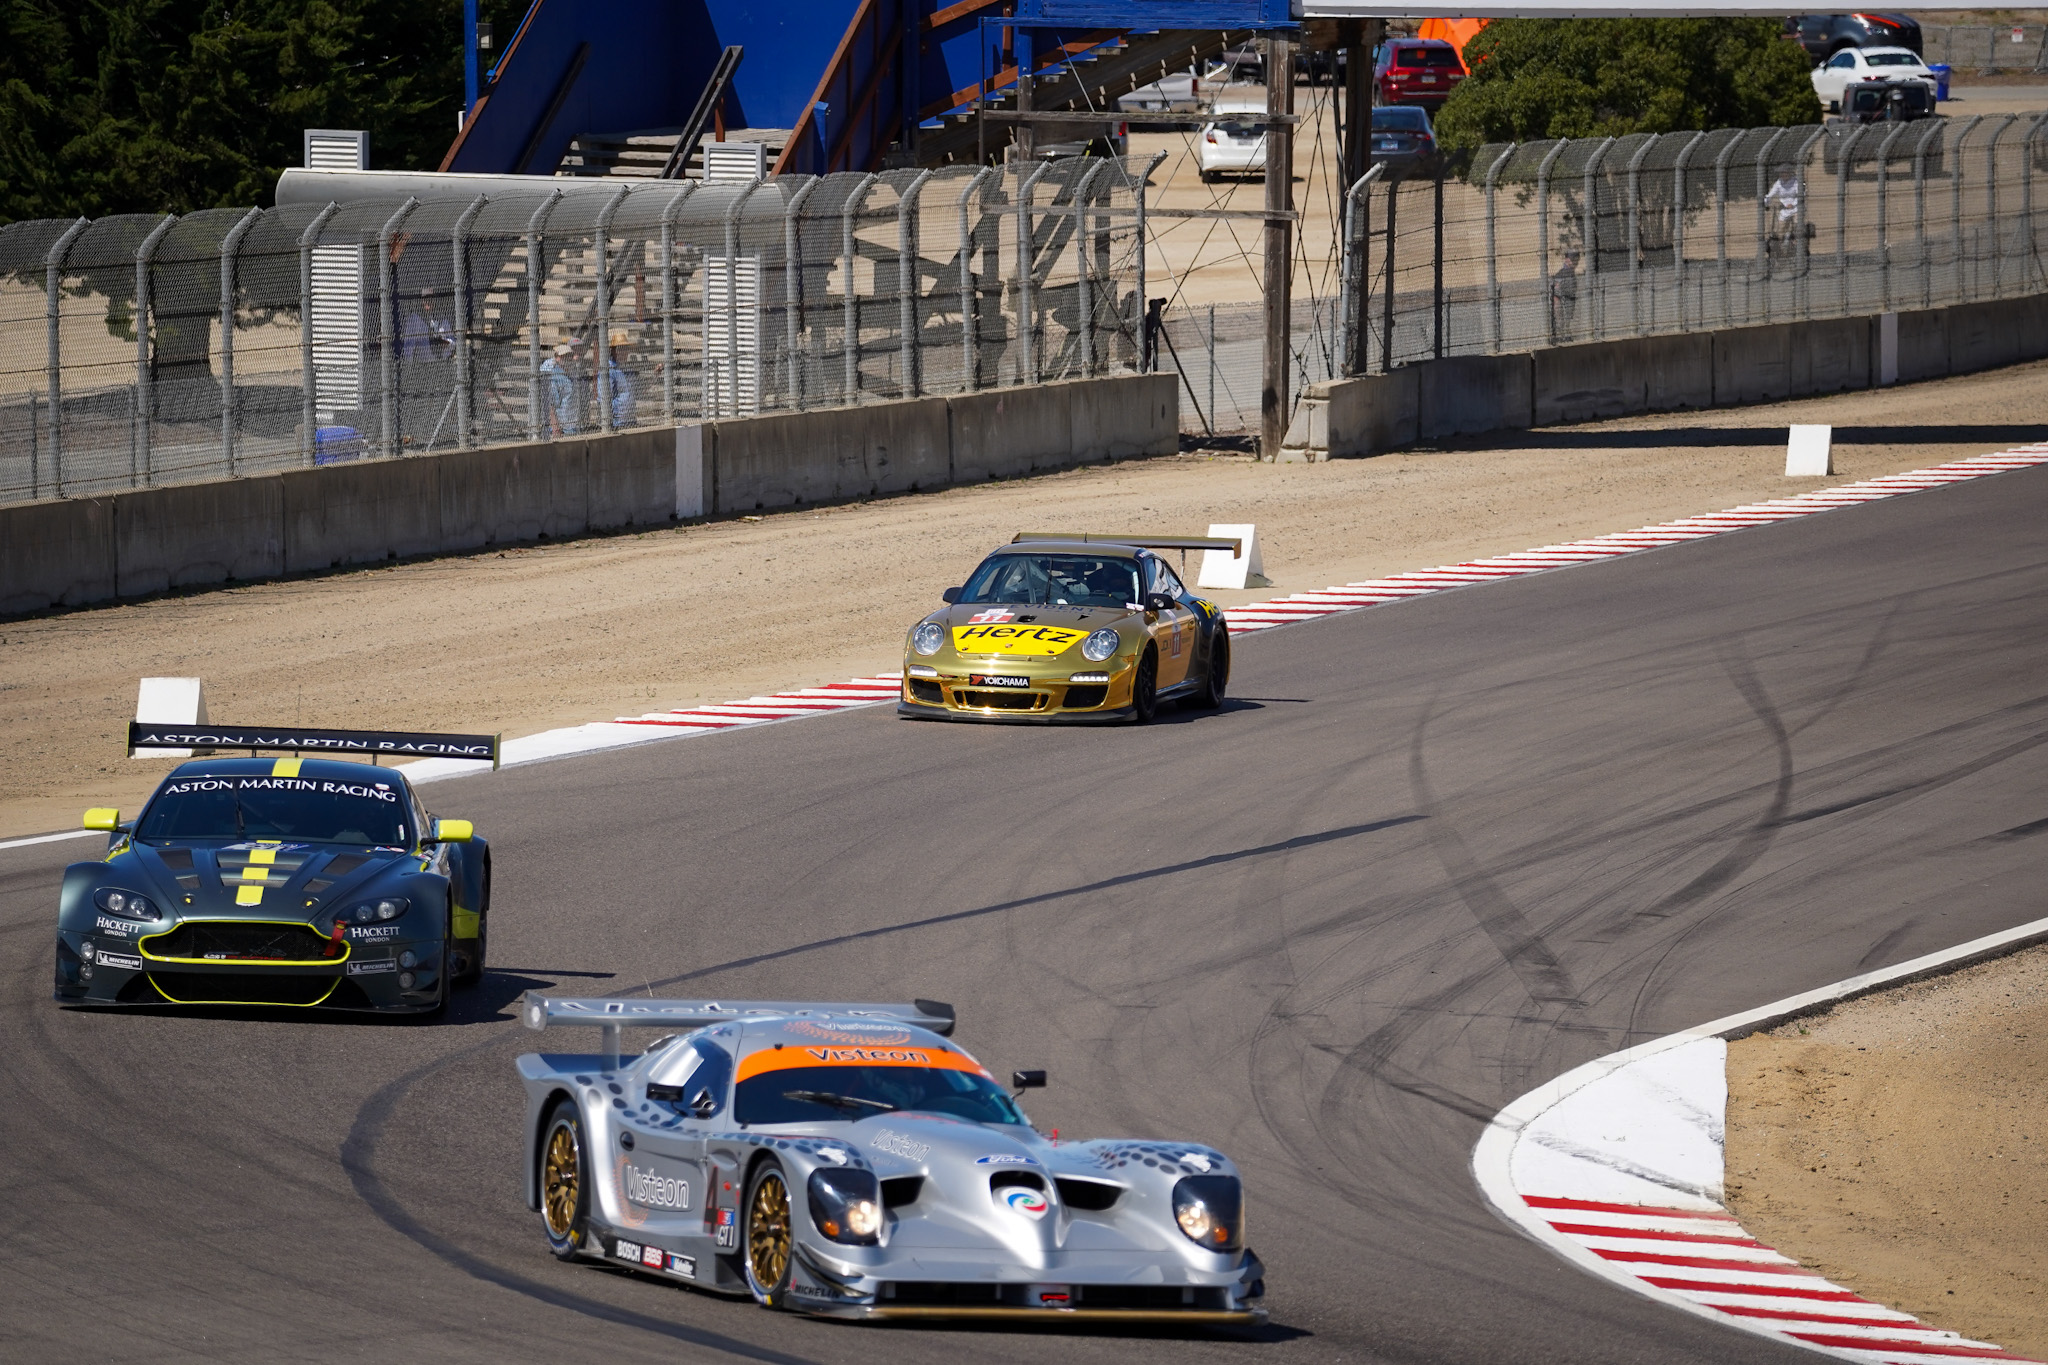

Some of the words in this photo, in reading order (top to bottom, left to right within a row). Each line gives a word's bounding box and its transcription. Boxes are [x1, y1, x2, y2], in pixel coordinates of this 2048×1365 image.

[958, 626, 1077, 644] Hertz
[984, 676, 1029, 687] YOKOHAMA
[378, 741, 489, 754] RACING
[165, 779, 234, 795] ASTON
[239, 779, 317, 791] MARTIN
[322, 782, 397, 803] RACING
[96, 916, 142, 934] HACKETT
[351, 926, 400, 938] HACKETT
[104, 929, 128, 938] LONDON
[365, 936, 390, 944] LONDON
[108, 955, 140, 966] MICHELIN
[361, 962, 395, 971] MICHELIN
[807, 1046, 930, 1063] Visteon
[870, 1128, 931, 1162] Visteon
[989, 1154, 1027, 1164] Ford
[627, 1165, 690, 1209] Visteon
[703, 1165, 719, 1238] 4
[616, 1240, 641, 1262] BOSCH
[643, 1246, 663, 1266] BBS
[795, 1283, 840, 1299] MICHELIN
